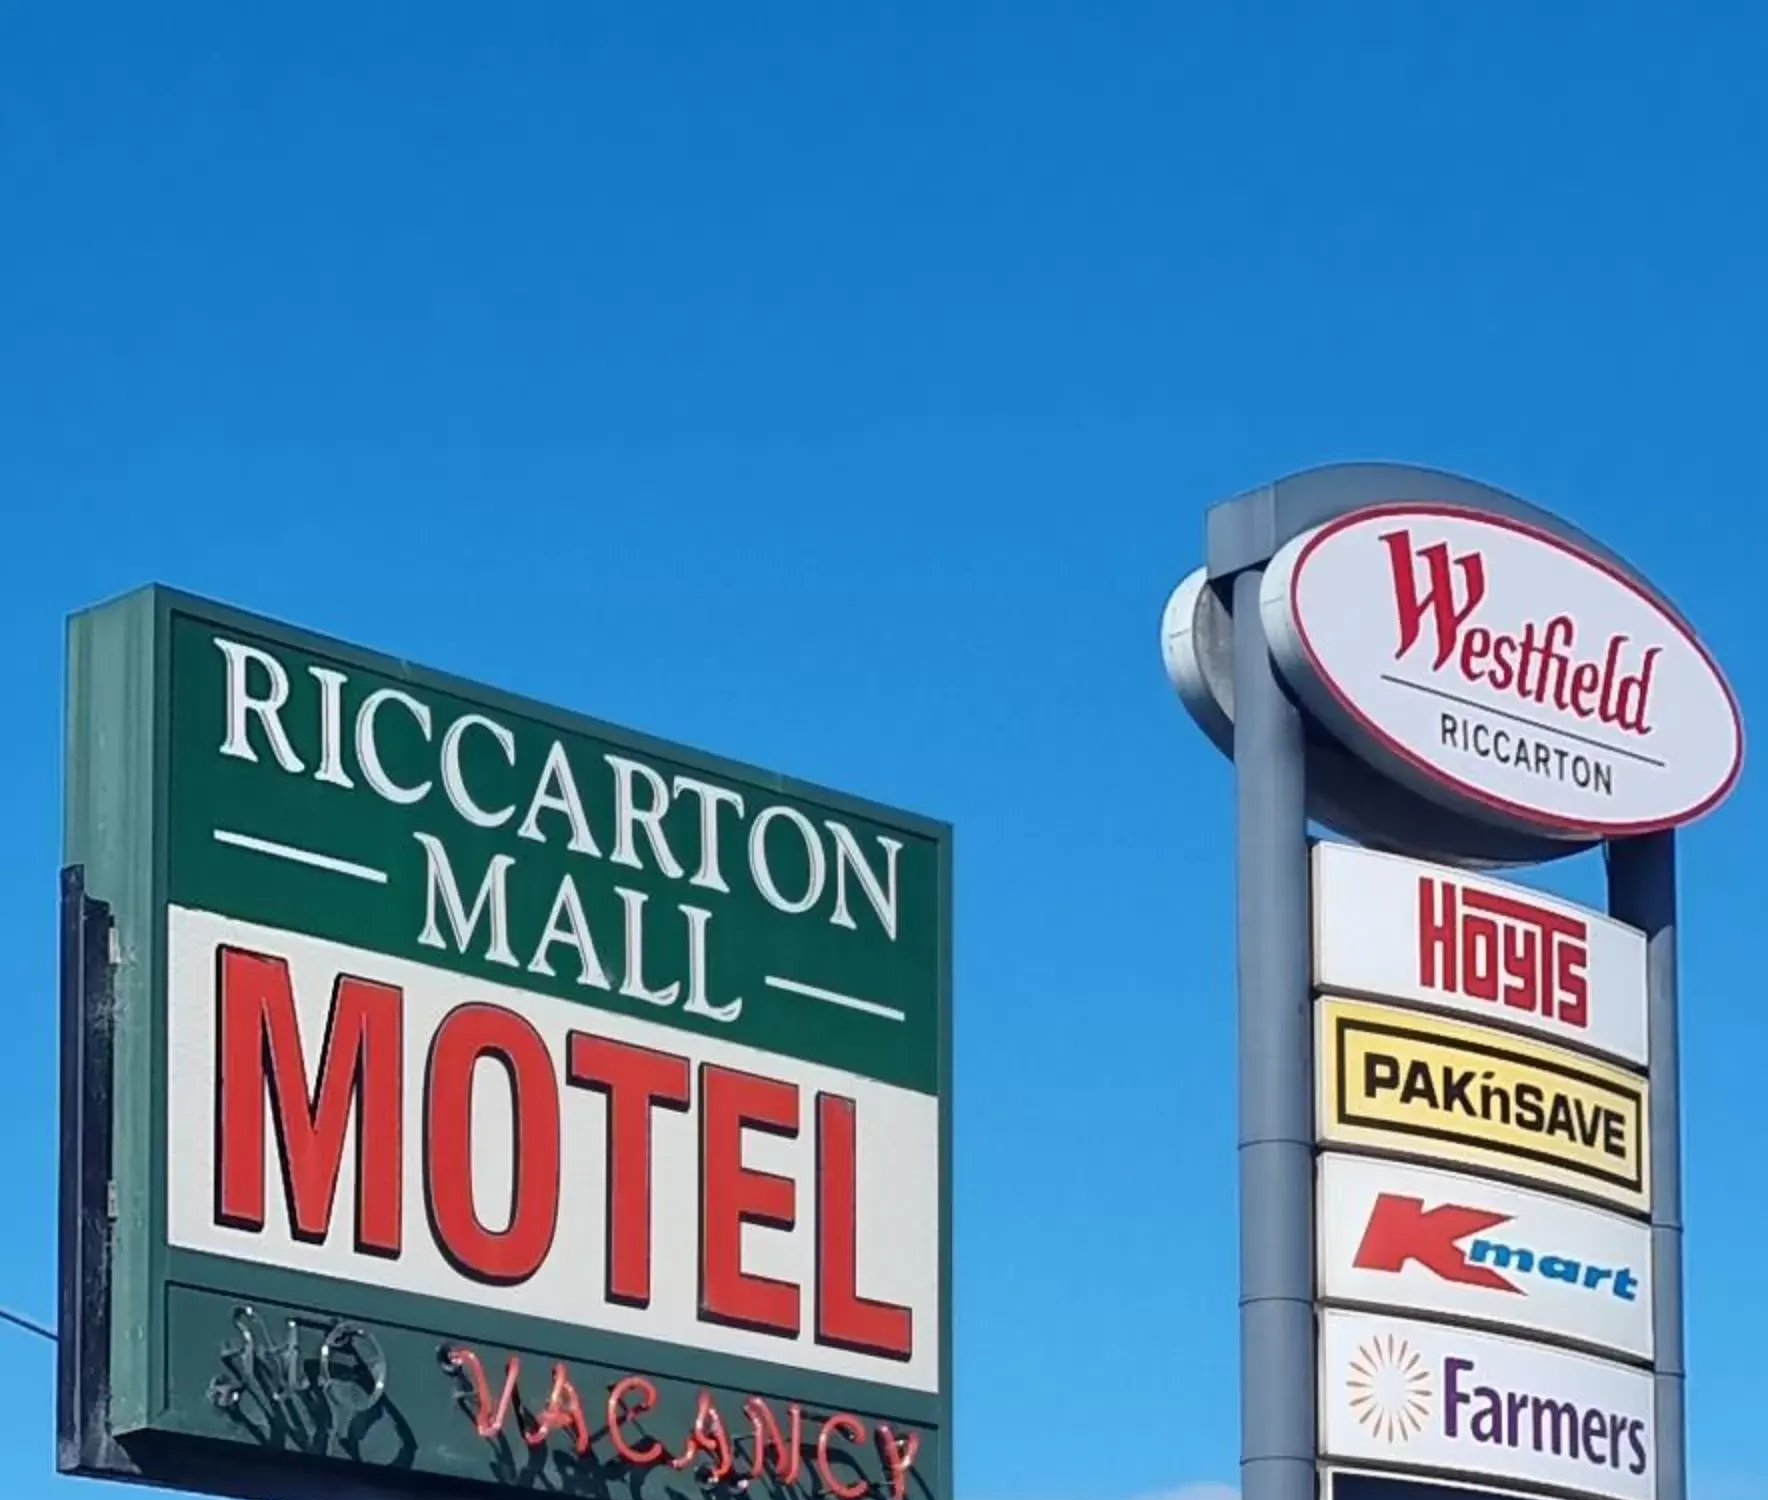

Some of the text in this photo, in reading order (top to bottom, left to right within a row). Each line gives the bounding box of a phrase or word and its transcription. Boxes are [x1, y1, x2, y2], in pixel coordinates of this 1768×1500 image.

[1378, 530, 1662, 737] Westfield
[213, 638, 904, 942] RICCARTON
[1440, 713, 1613, 797] RICCARTON
[413, 832, 742, 1023] MALL
[214, 944, 912, 1362] MOTEL
[1352, 1192, 1638, 1301] Kmart
[1443, 1357, 1647, 1477] Farmers
